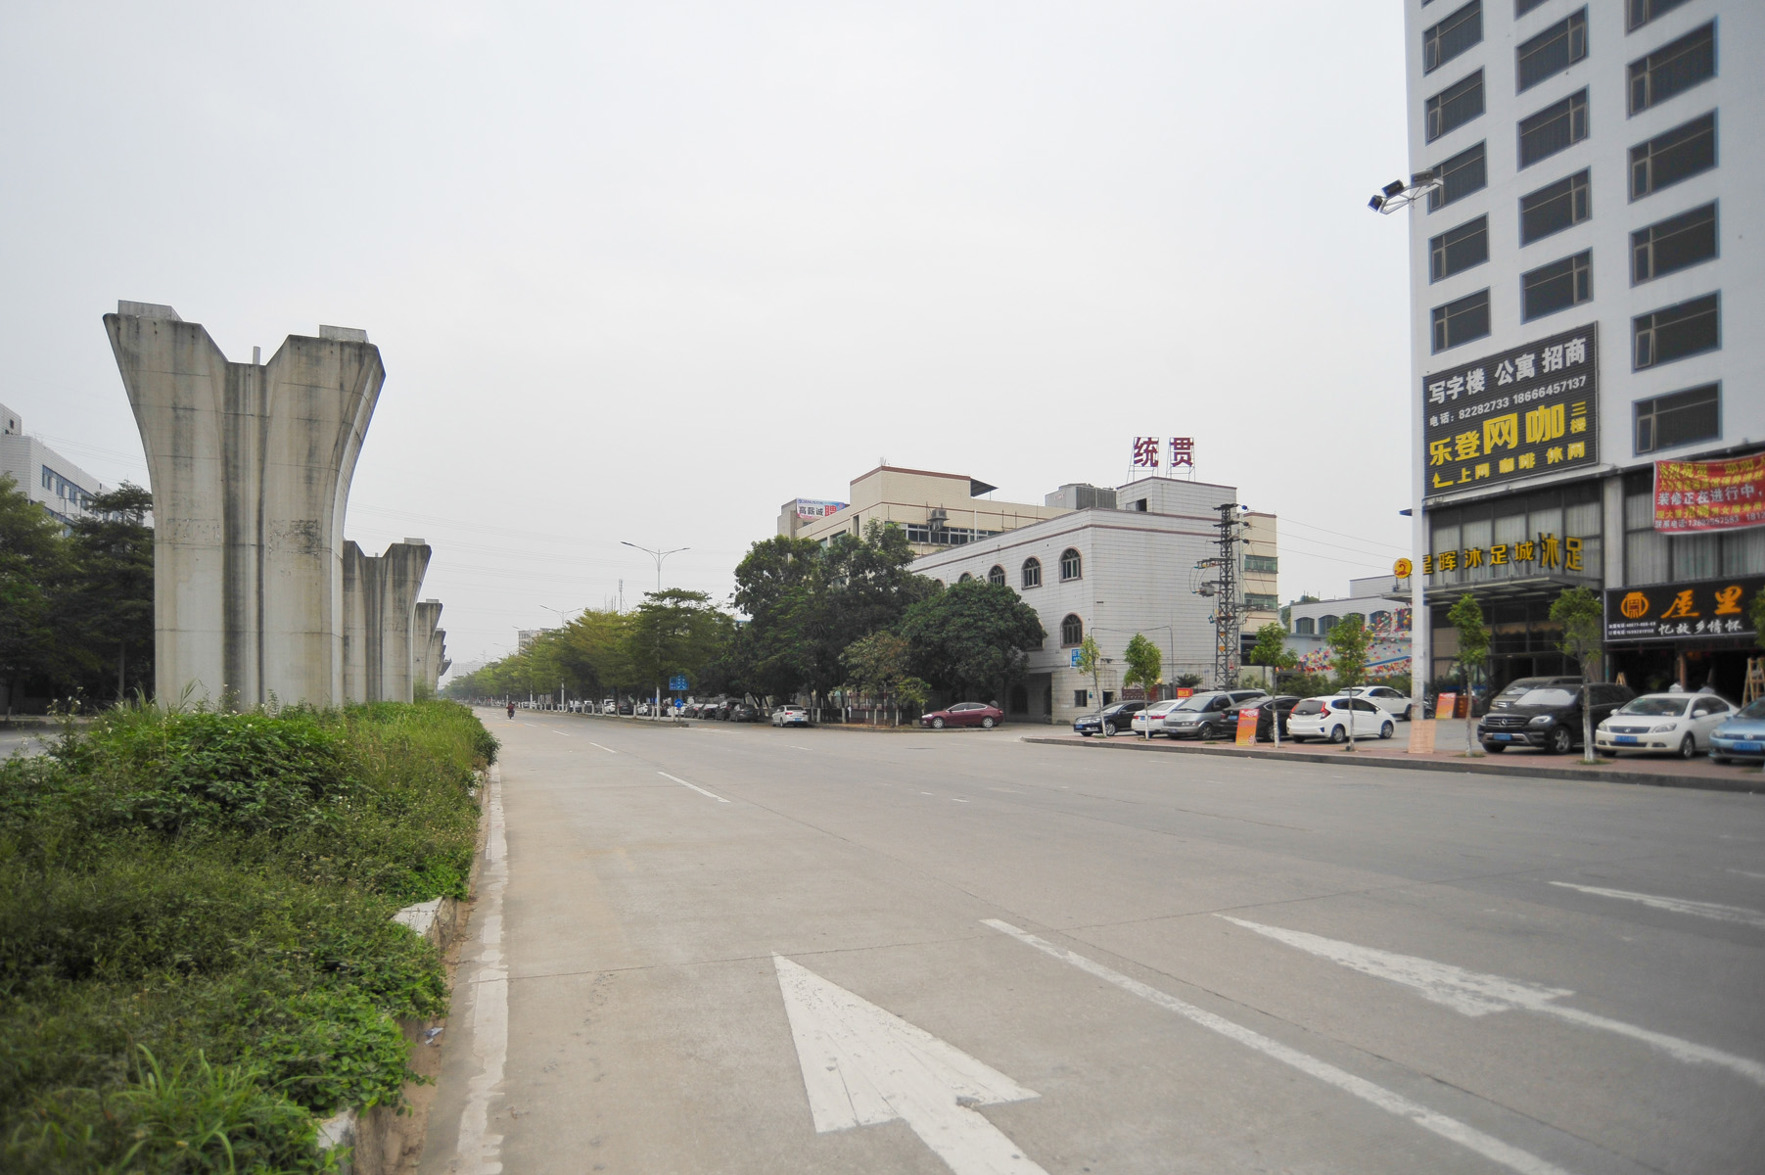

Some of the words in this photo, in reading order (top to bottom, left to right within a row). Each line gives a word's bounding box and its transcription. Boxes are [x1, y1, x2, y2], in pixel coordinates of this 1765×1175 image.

[1429, 368, 1485, 404] 写字楼
[1494, 353, 1535, 386] 公寓
[1542, 338, 1586, 373] 招商
[1458, 397, 1509, 419] 82282733
[1513, 375, 1586, 405] 18666457137
[1570, 401, 1587, 434] 三楼
[1134, 437, 1194, 467] 统贯
[1429, 403, 1565, 466] 乐登网咖
[1457, 462, 1490, 484] 上网
[1499, 452, 1535, 474] 咖啡
[1546, 441, 1586, 465] 休闲
[1539, 532, 1584, 571] 沐足
[1658, 618, 1743, 636] 忆故乡情怀
